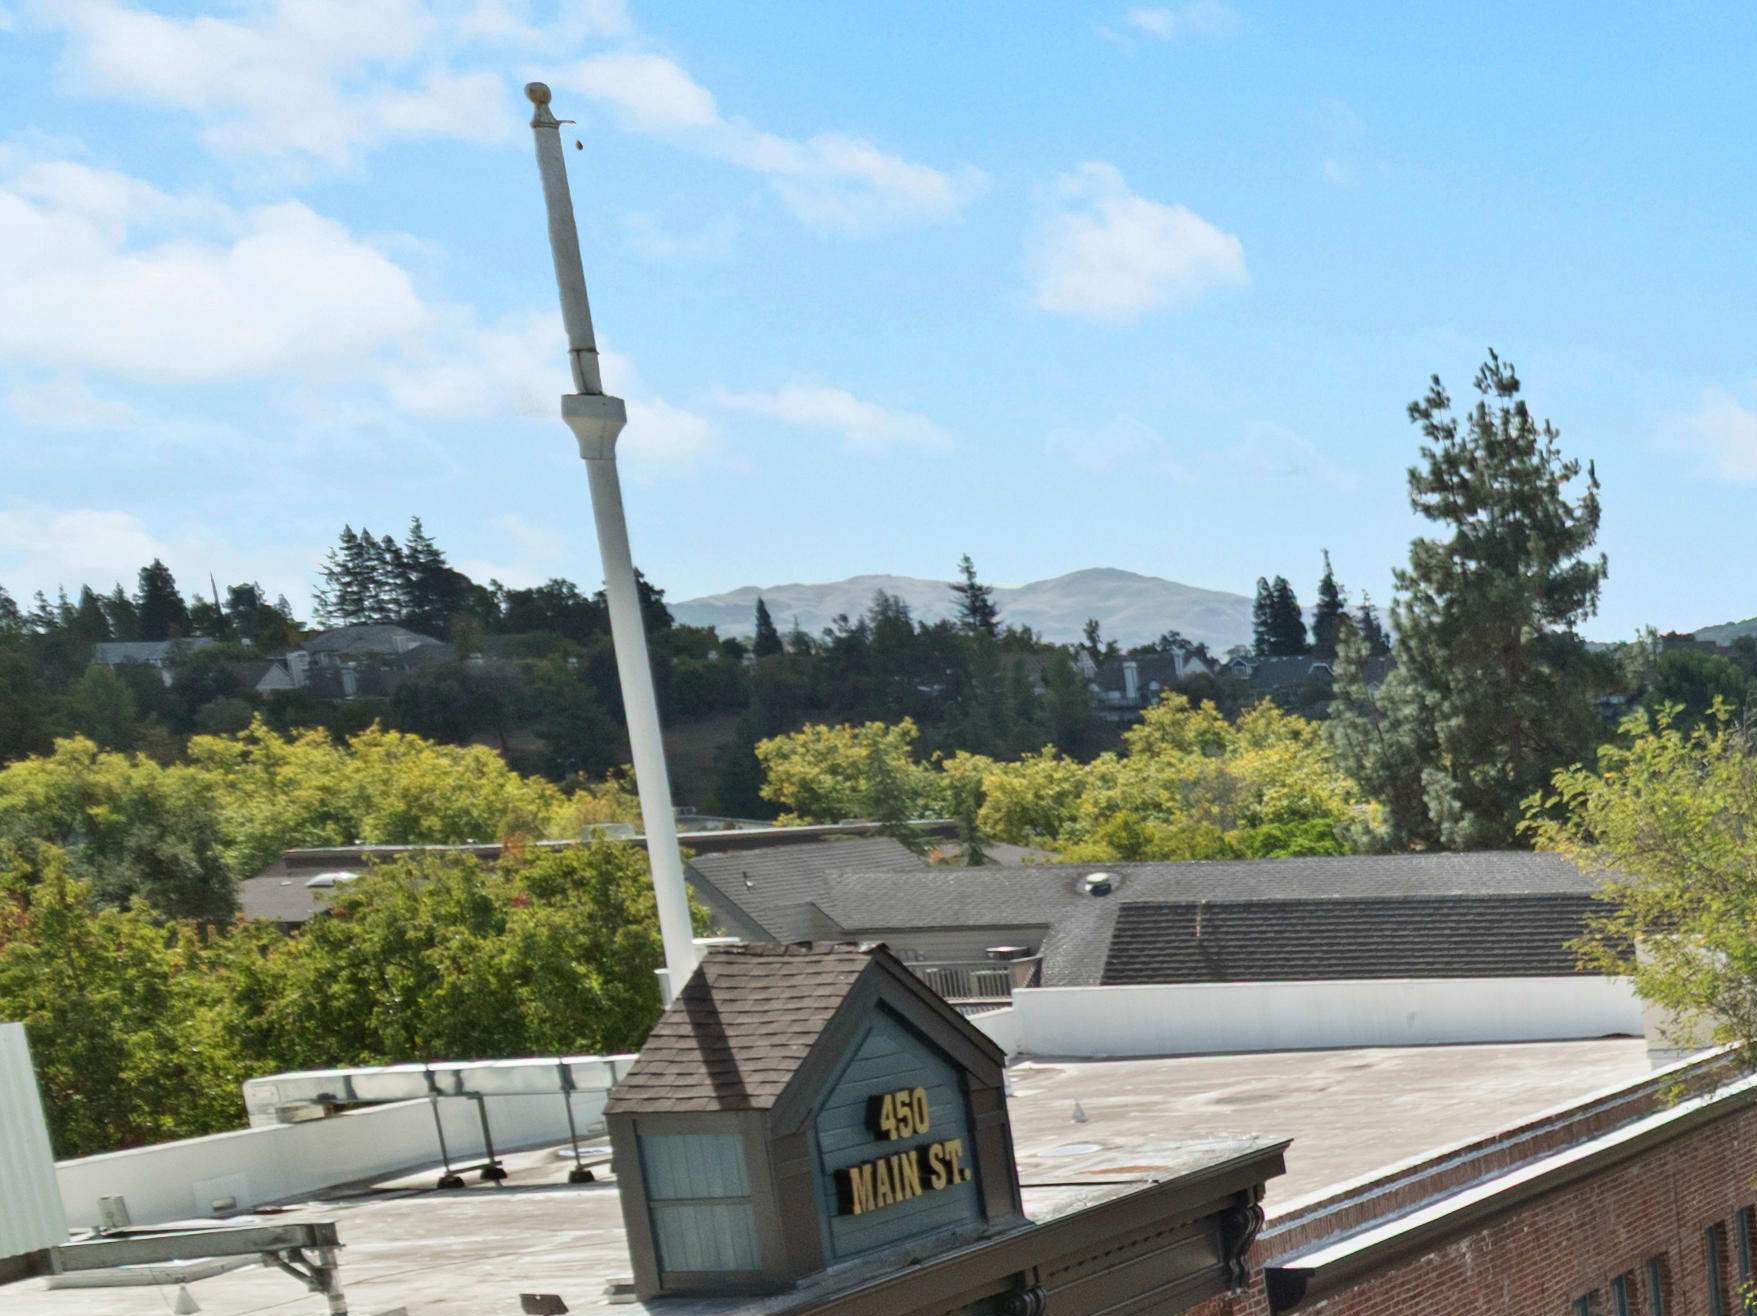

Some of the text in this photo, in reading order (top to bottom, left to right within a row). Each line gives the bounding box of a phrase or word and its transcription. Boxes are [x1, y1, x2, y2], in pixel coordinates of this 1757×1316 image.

[880, 1087, 929, 1141] 450
[849, 1139, 972, 1215] MAIN ST.
